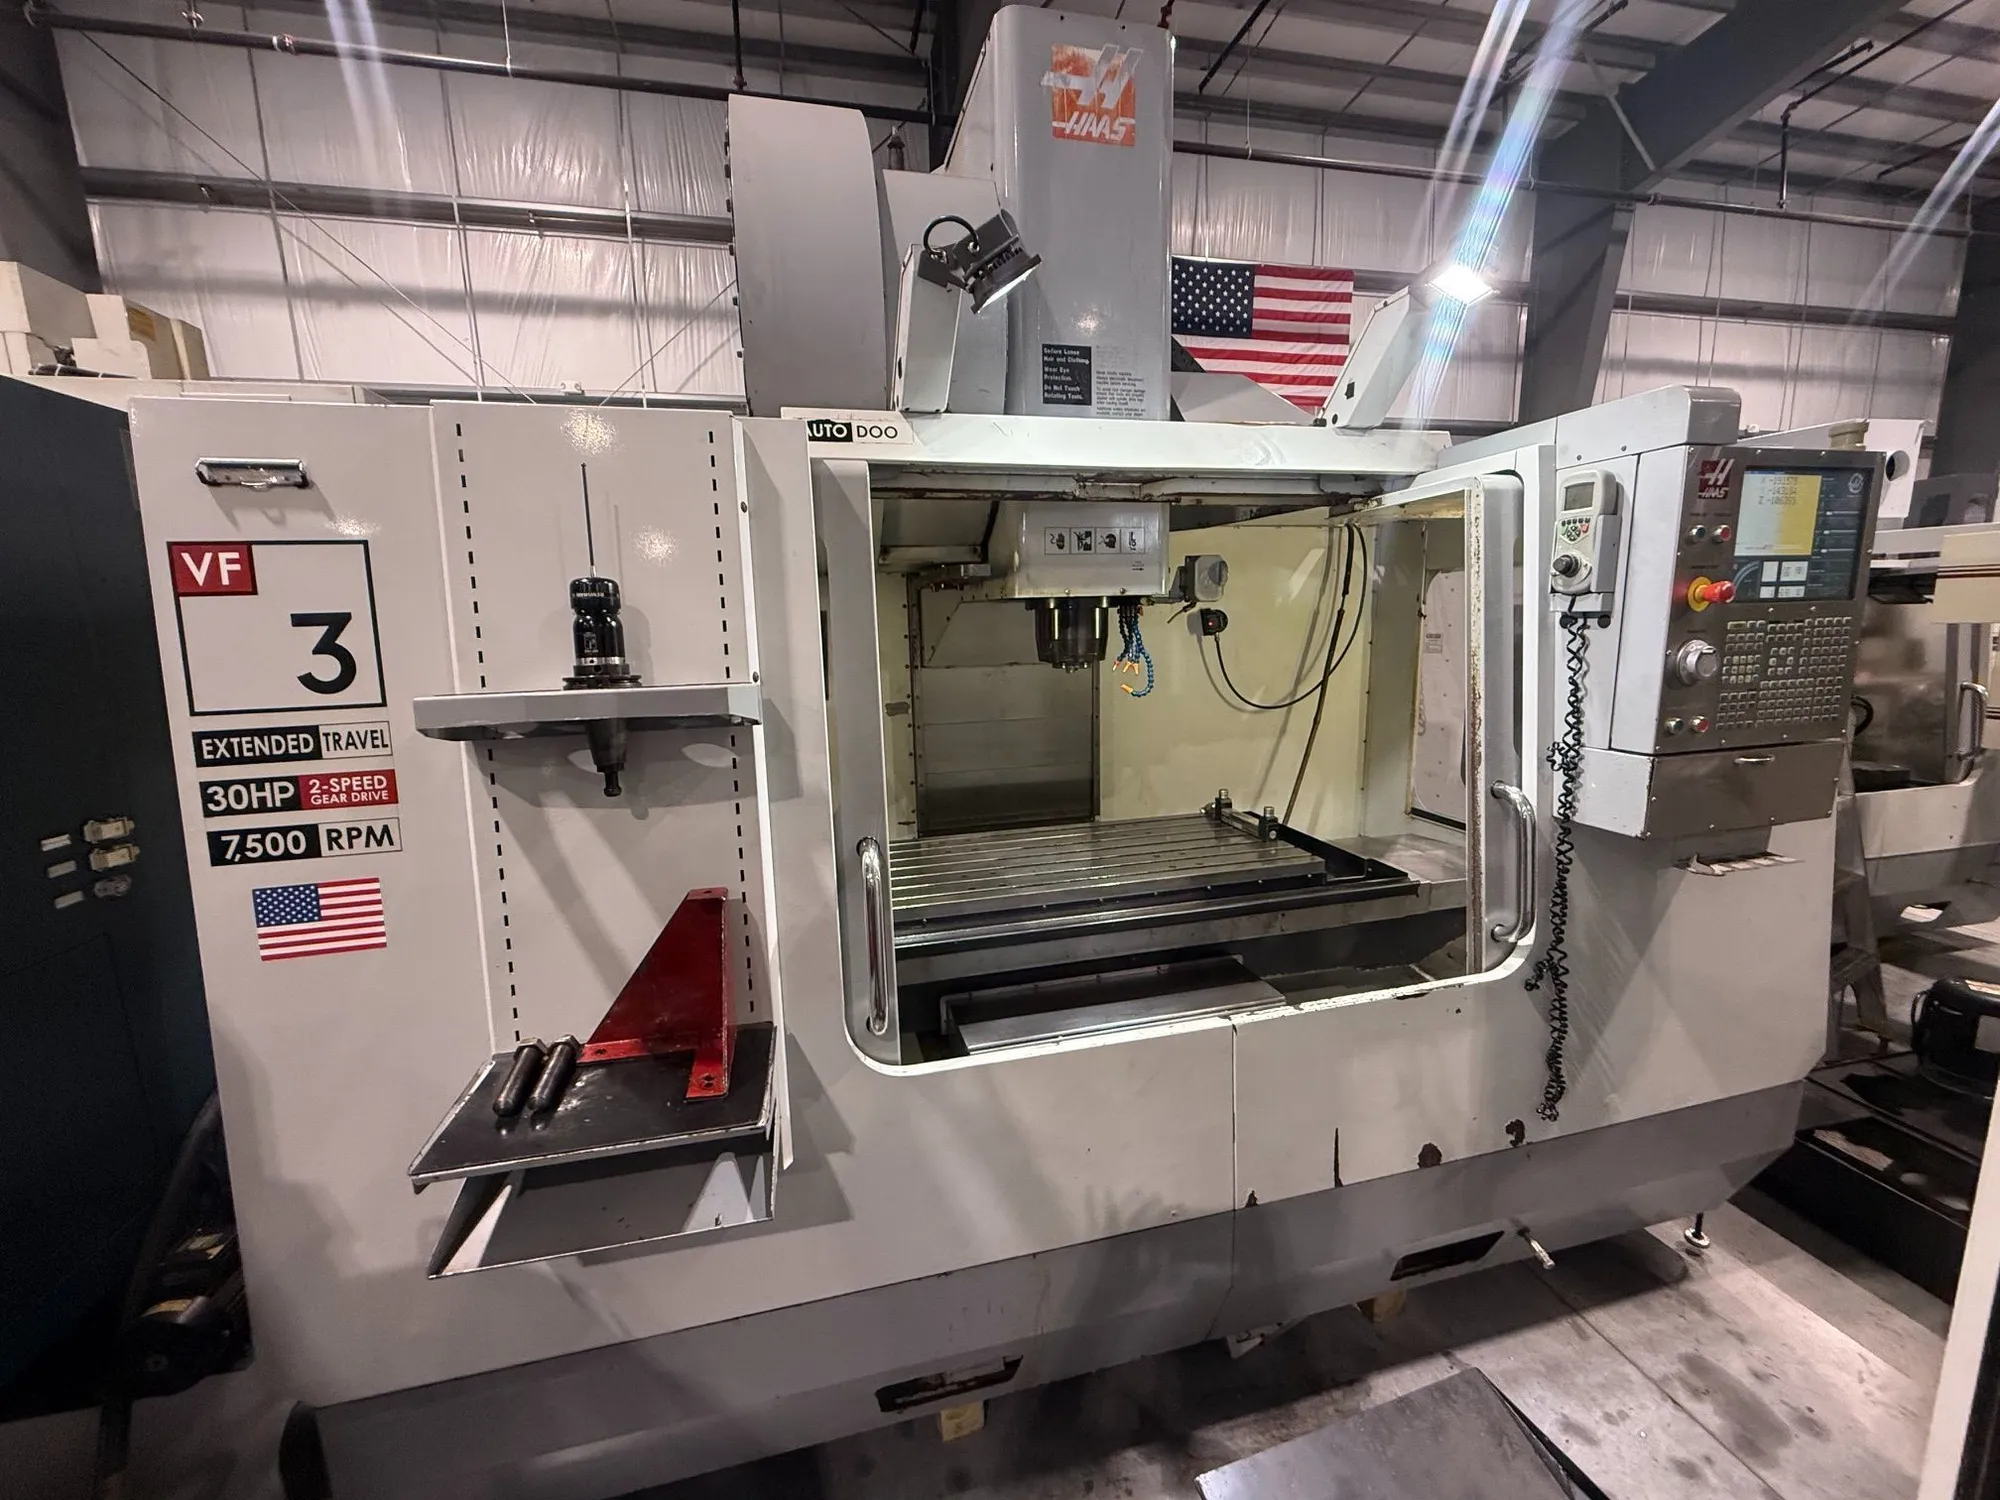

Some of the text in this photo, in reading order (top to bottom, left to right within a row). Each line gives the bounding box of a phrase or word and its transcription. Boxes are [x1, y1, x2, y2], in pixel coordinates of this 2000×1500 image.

[1052, 111, 1135, 142] HAAS
[1064, 348, 1080, 356] Loose
[1059, 366, 1070, 374] Eye
[1044, 392, 1067, 400] Rotating
[1698, 487, 1730, 498] HAAS
[181, 552, 241, 586] VF
[290, 612, 357, 695] 3
[201, 729, 389, 760] EXTENDED TRAVEL
[206, 781, 295, 812] 30HP
[308, 775, 388, 794] 2-SPEED
[310, 790, 389, 805] GEAR DRIVE
[221, 824, 395, 863] 7,500 RPM
